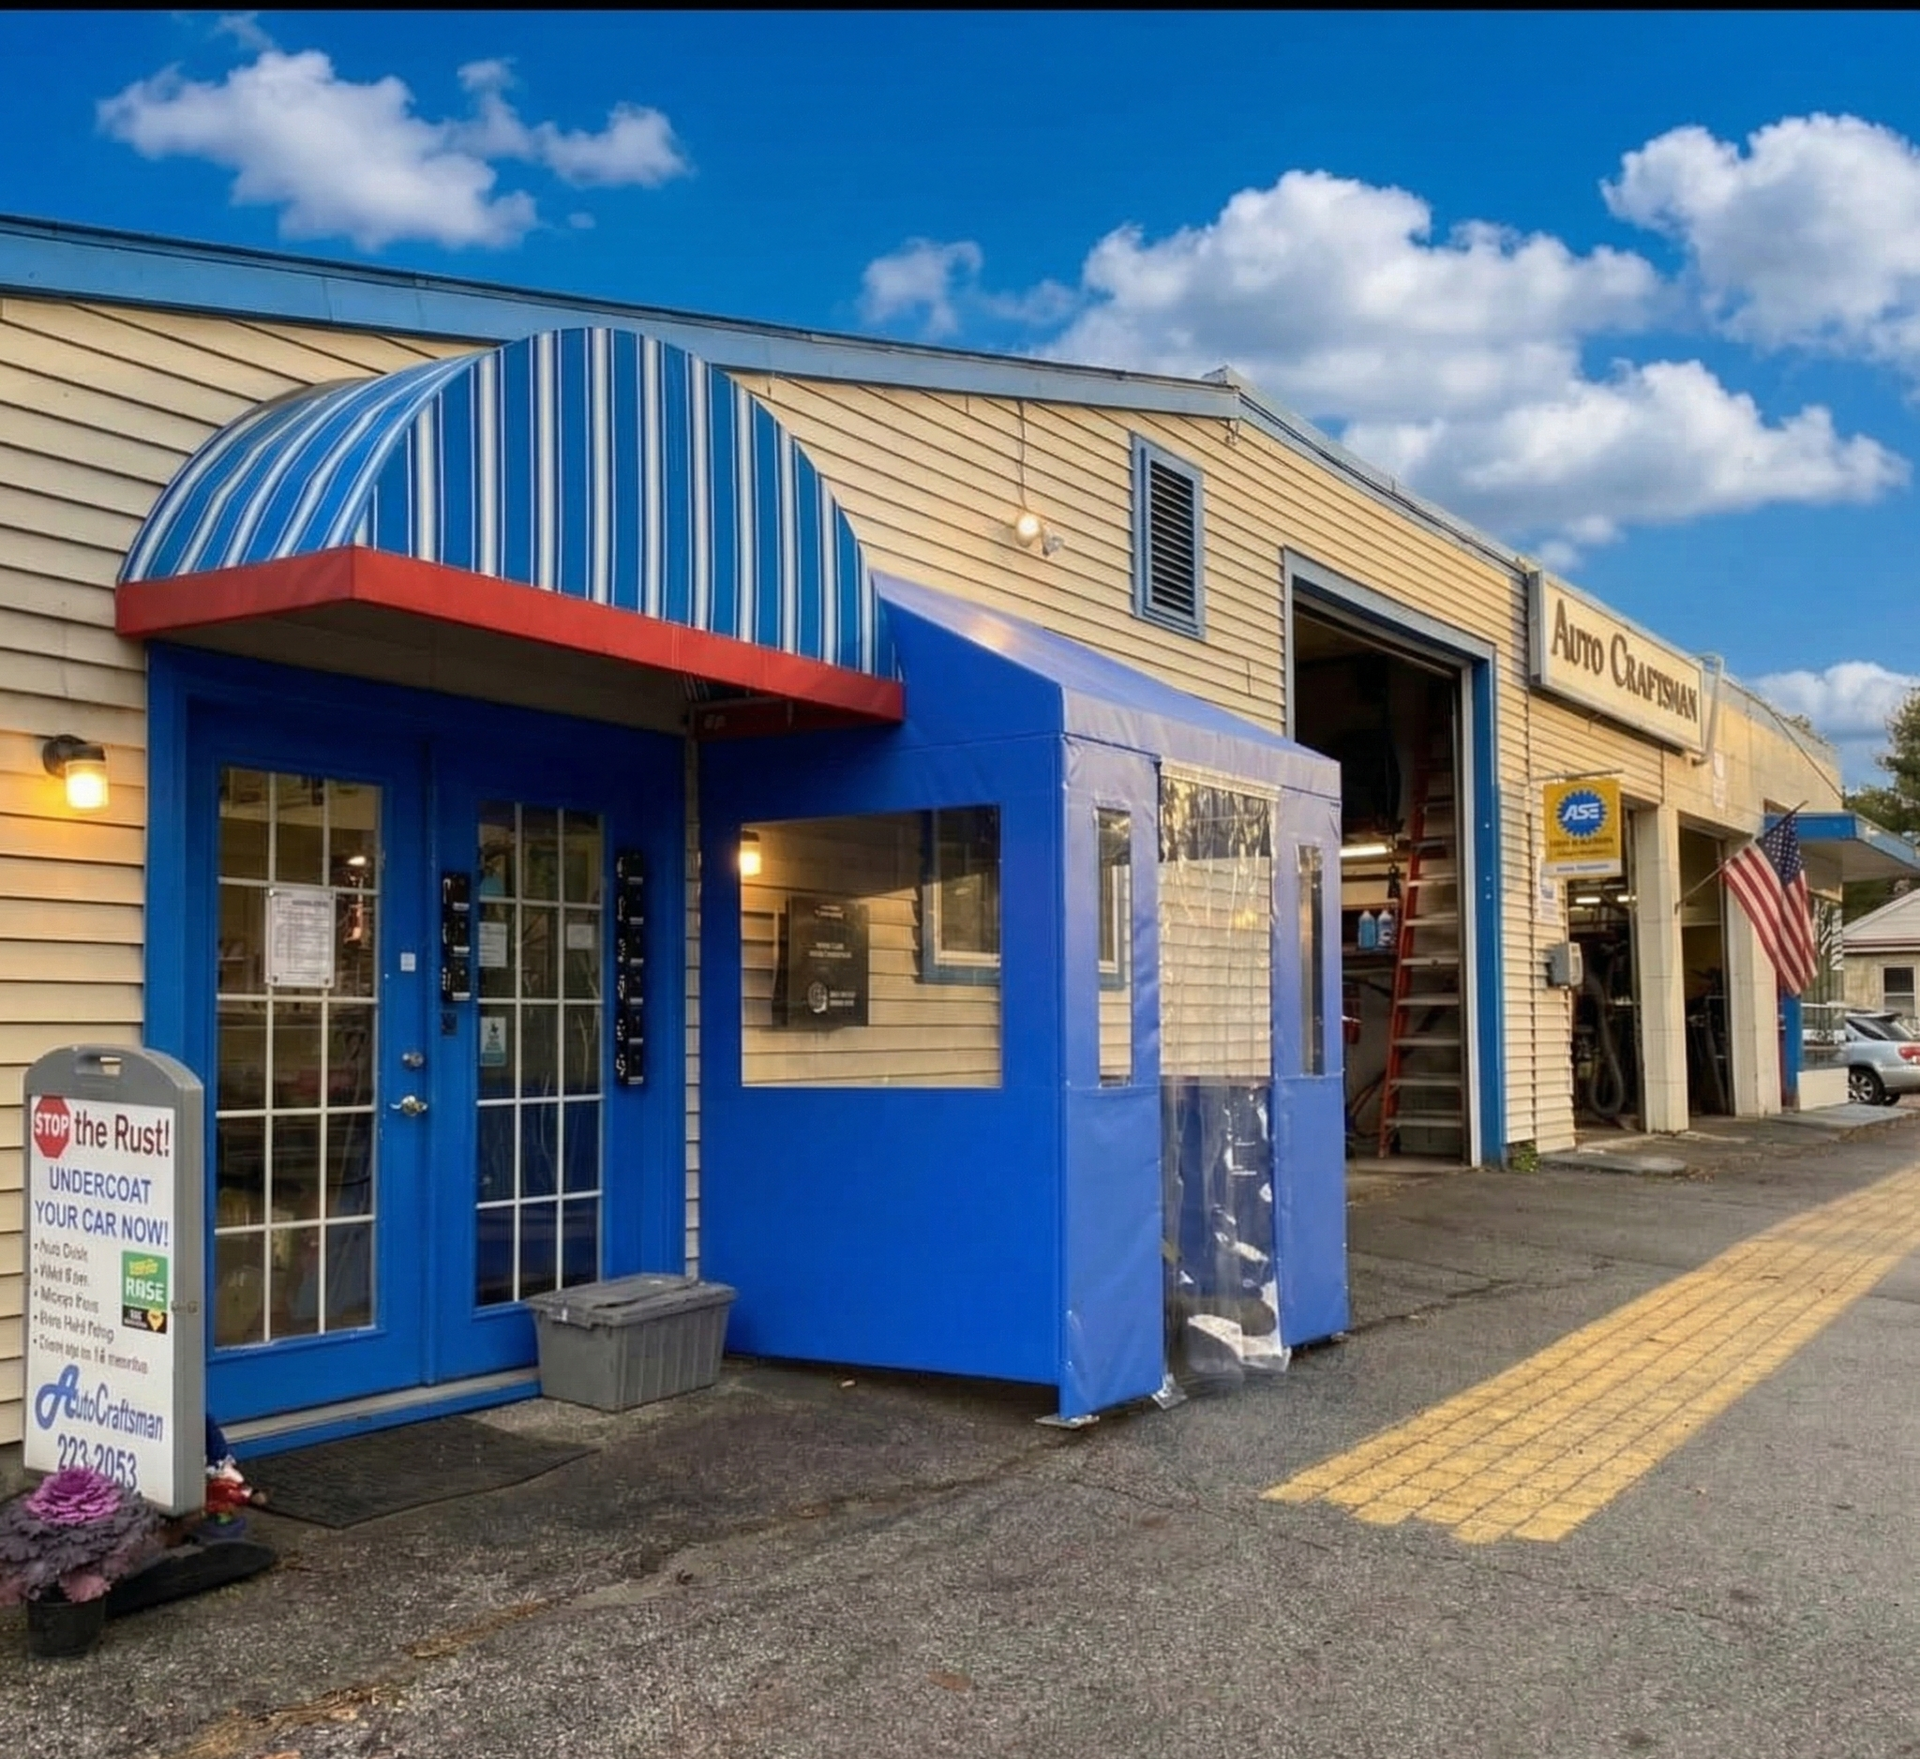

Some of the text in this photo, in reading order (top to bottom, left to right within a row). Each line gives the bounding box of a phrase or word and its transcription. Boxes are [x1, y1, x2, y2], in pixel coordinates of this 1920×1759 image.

[1551, 598, 1698, 723] AUTO CRAFTSMAN
[1562, 802, 1600, 822] ASE
[35, 1110, 170, 1157] STOP the Rust!
[49, 1166, 152, 1204] UNDERCOAT
[35, 1200, 169, 1247] YOUR CAR NOW!
[35, 1363, 164, 1442] AutoCraftsman
